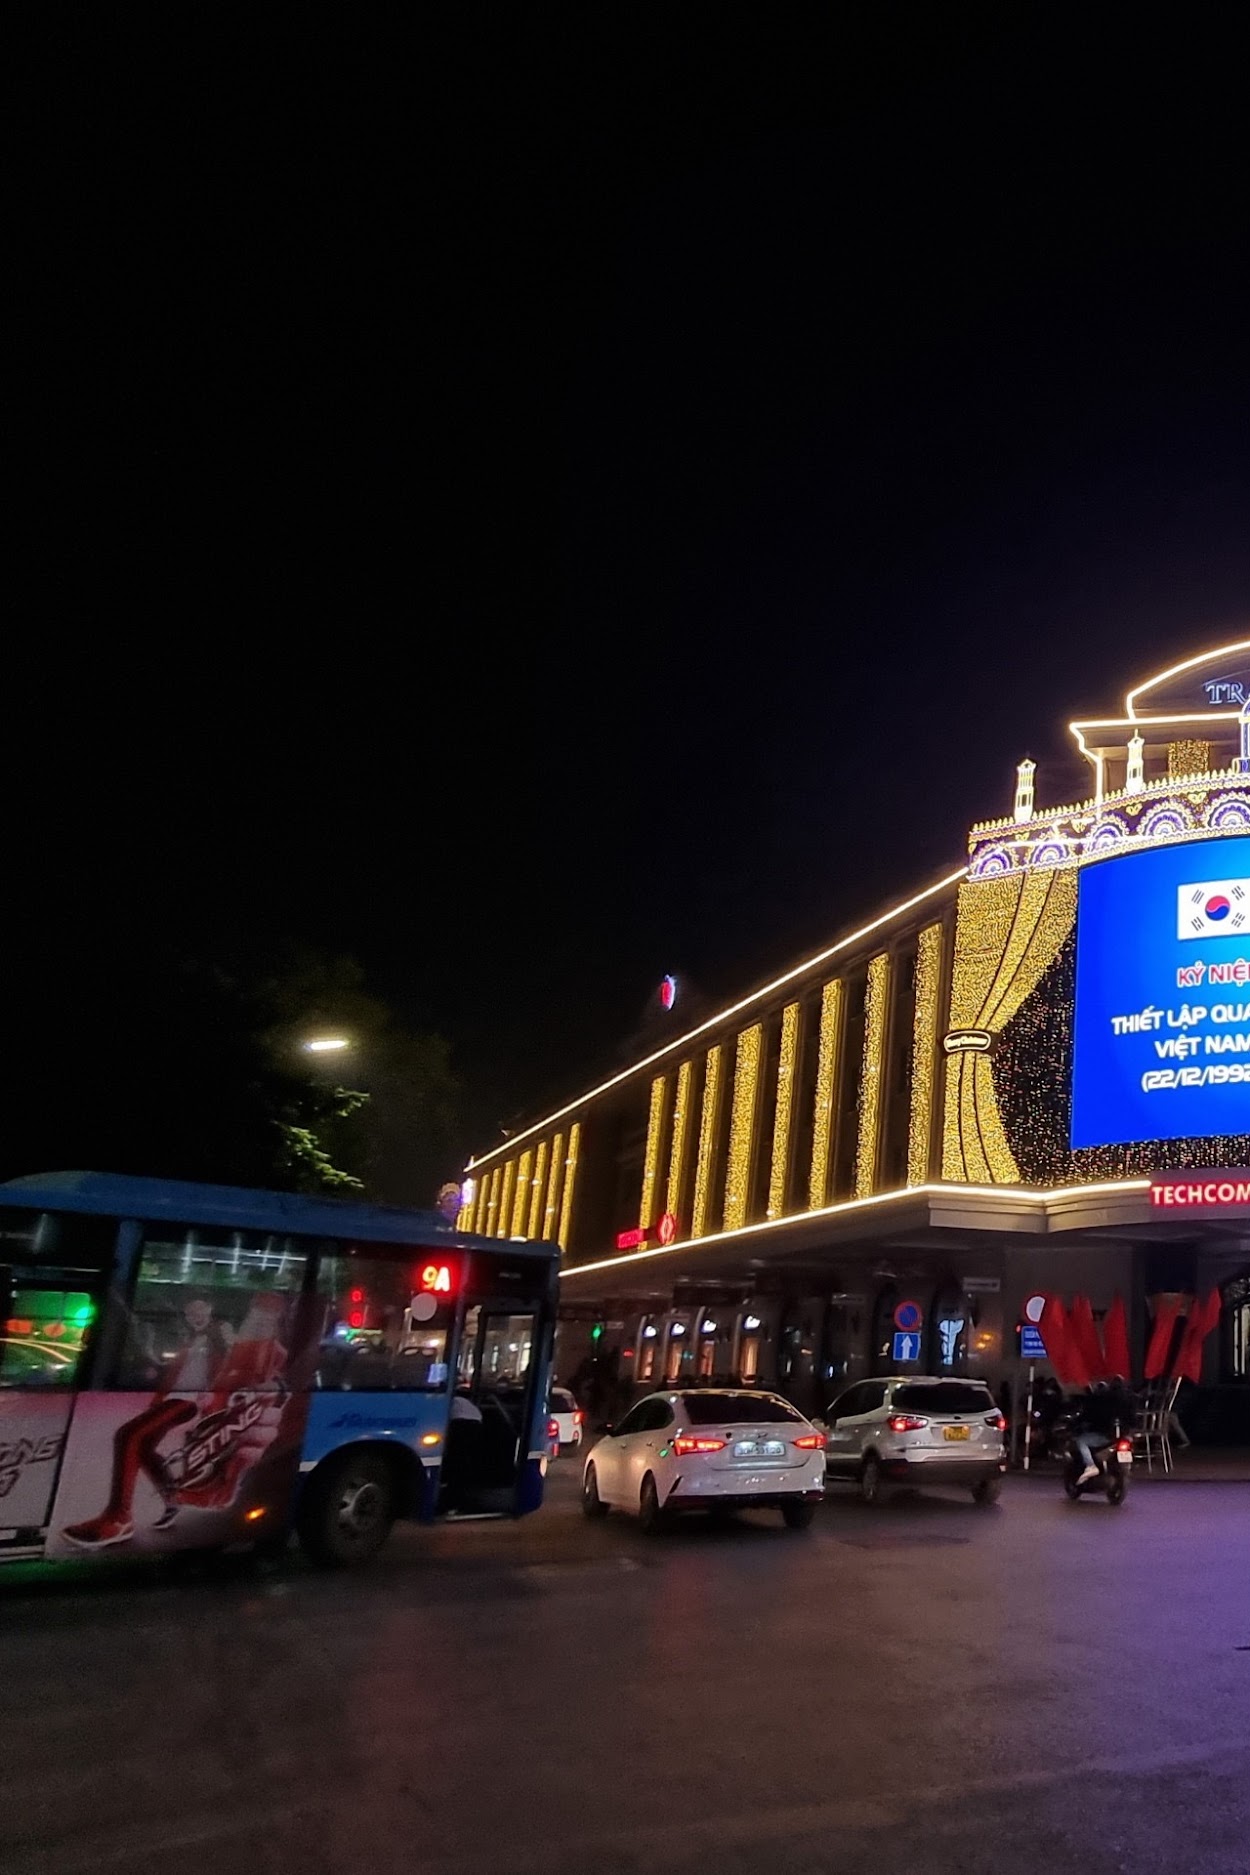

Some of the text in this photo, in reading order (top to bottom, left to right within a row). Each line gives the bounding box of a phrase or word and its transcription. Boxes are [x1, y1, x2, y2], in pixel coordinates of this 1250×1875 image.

[1111, 1005, 1164, 1035] THIẾT
[1167, 1003, 1207, 1031] LẬP
[1154, 1034, 1202, 1060] VIỆT
[422, 1266, 450, 1292] 9A
